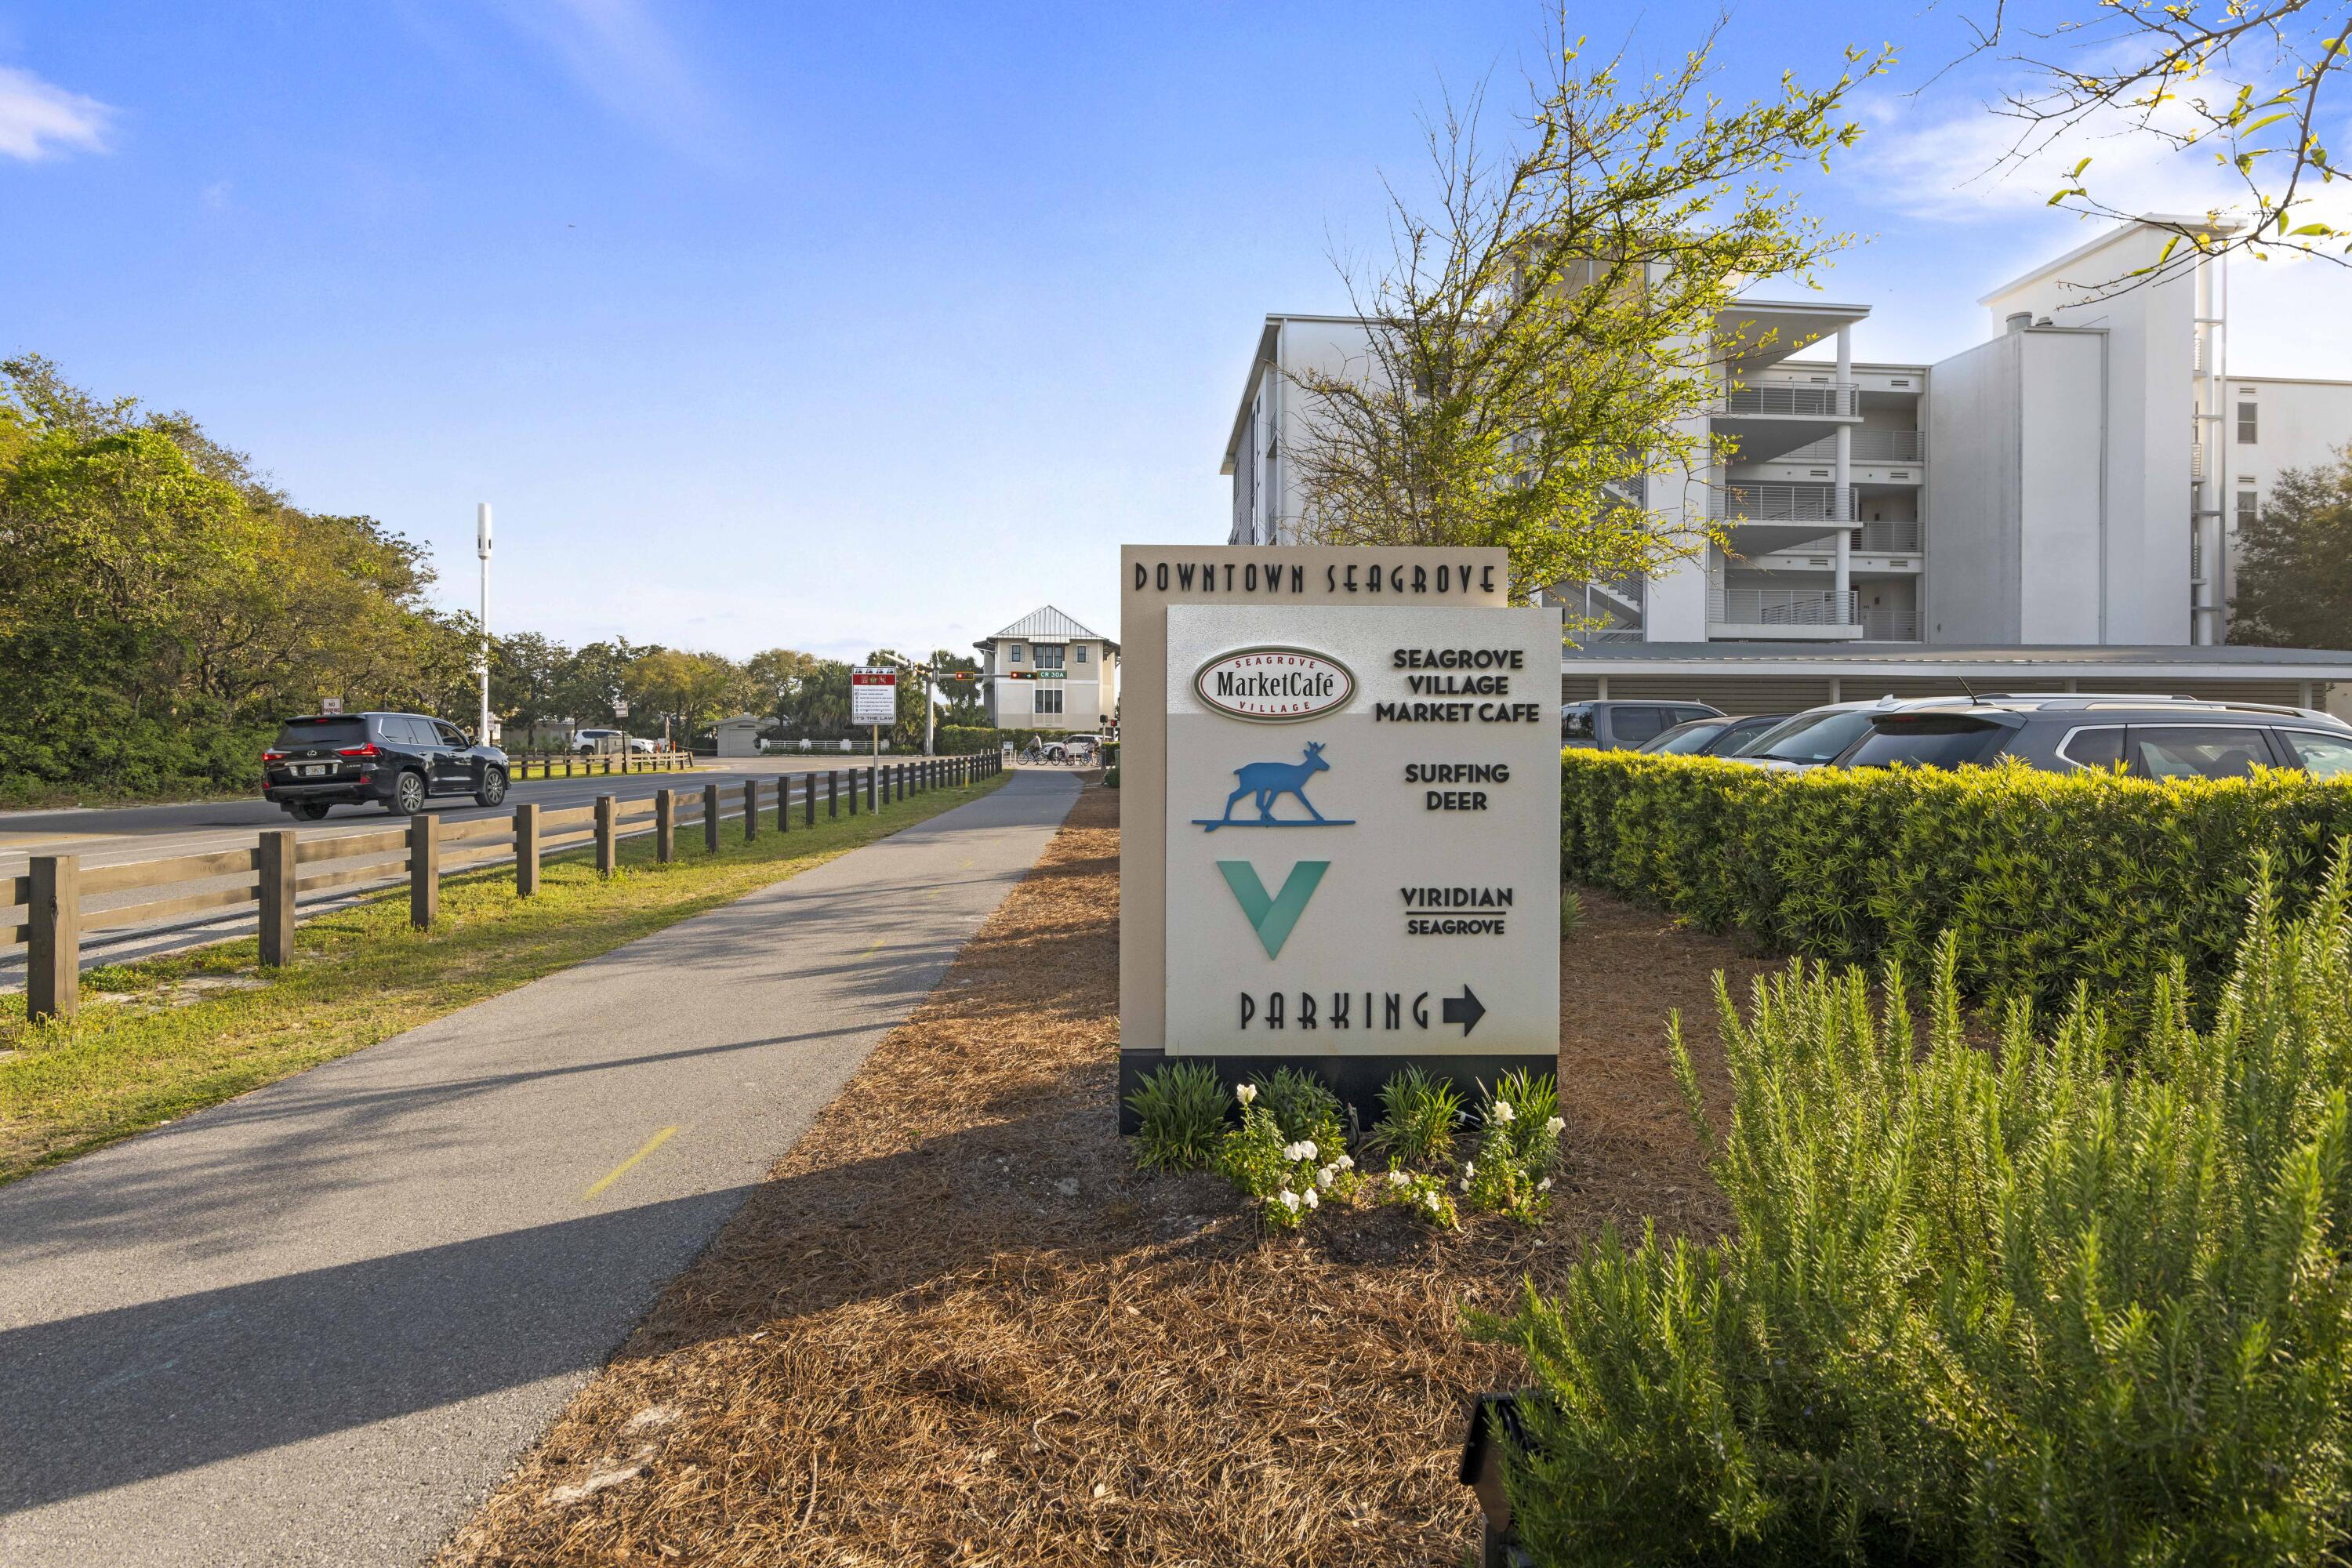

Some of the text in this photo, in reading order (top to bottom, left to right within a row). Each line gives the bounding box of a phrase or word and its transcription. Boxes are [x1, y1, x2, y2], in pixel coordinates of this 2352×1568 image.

[1135, 562, 1495, 593] DOWNTOWN SEAGROVE
[1235, 656, 1316, 669] SEAGROVE
[1393, 648, 1523, 670] SEAGROVE
[1216, 671, 1334, 697] MarketCafé
[1407, 675, 1509, 695] VILLAGE
[1240, 701, 1310, 713] VILLAGE
[1376, 702, 1540, 723] MARKET CAFE
[1405, 764, 1510, 783] SURFING
[1426, 790, 1488, 811] DEER
[1400, 887, 1513, 907] VIRIDIAN
[1407, 919, 1504, 935] SEAGROVE
[1240, 991, 1429, 1030] PARKING
